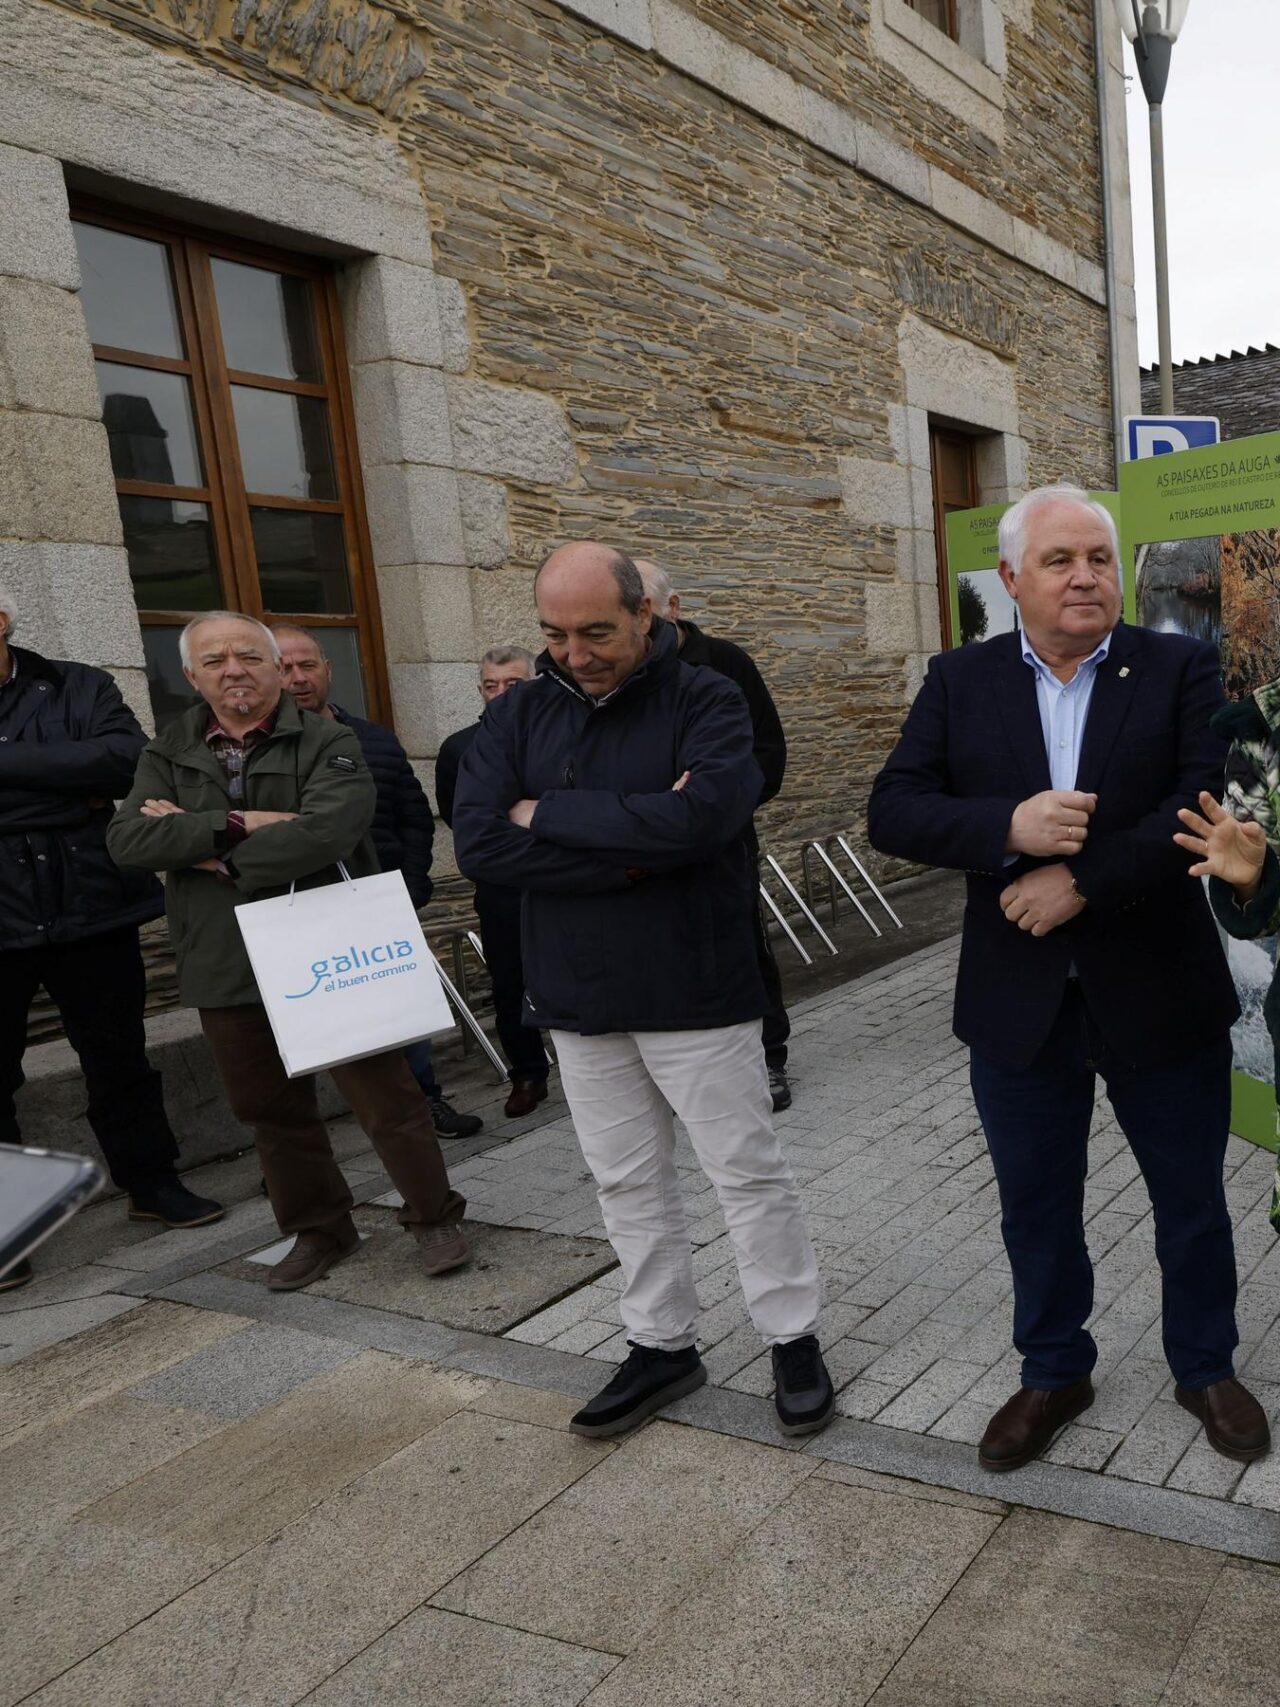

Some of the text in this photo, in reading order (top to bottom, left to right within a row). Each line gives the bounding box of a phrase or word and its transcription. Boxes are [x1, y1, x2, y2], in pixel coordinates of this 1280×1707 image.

[1136, 426, 1189, 460] P
[1157, 455, 1271, 488] AS PAISAXES DA AUGA
[1169, 513, 1174, 521] A
[1190, 506, 1219, 519] PEGADA
[1221, 505, 1232, 515] NA
[1233, 498, 1275, 513] NATUREZA
[290, 940, 413, 993] galicia
[324, 962, 417, 992] el buen camino
